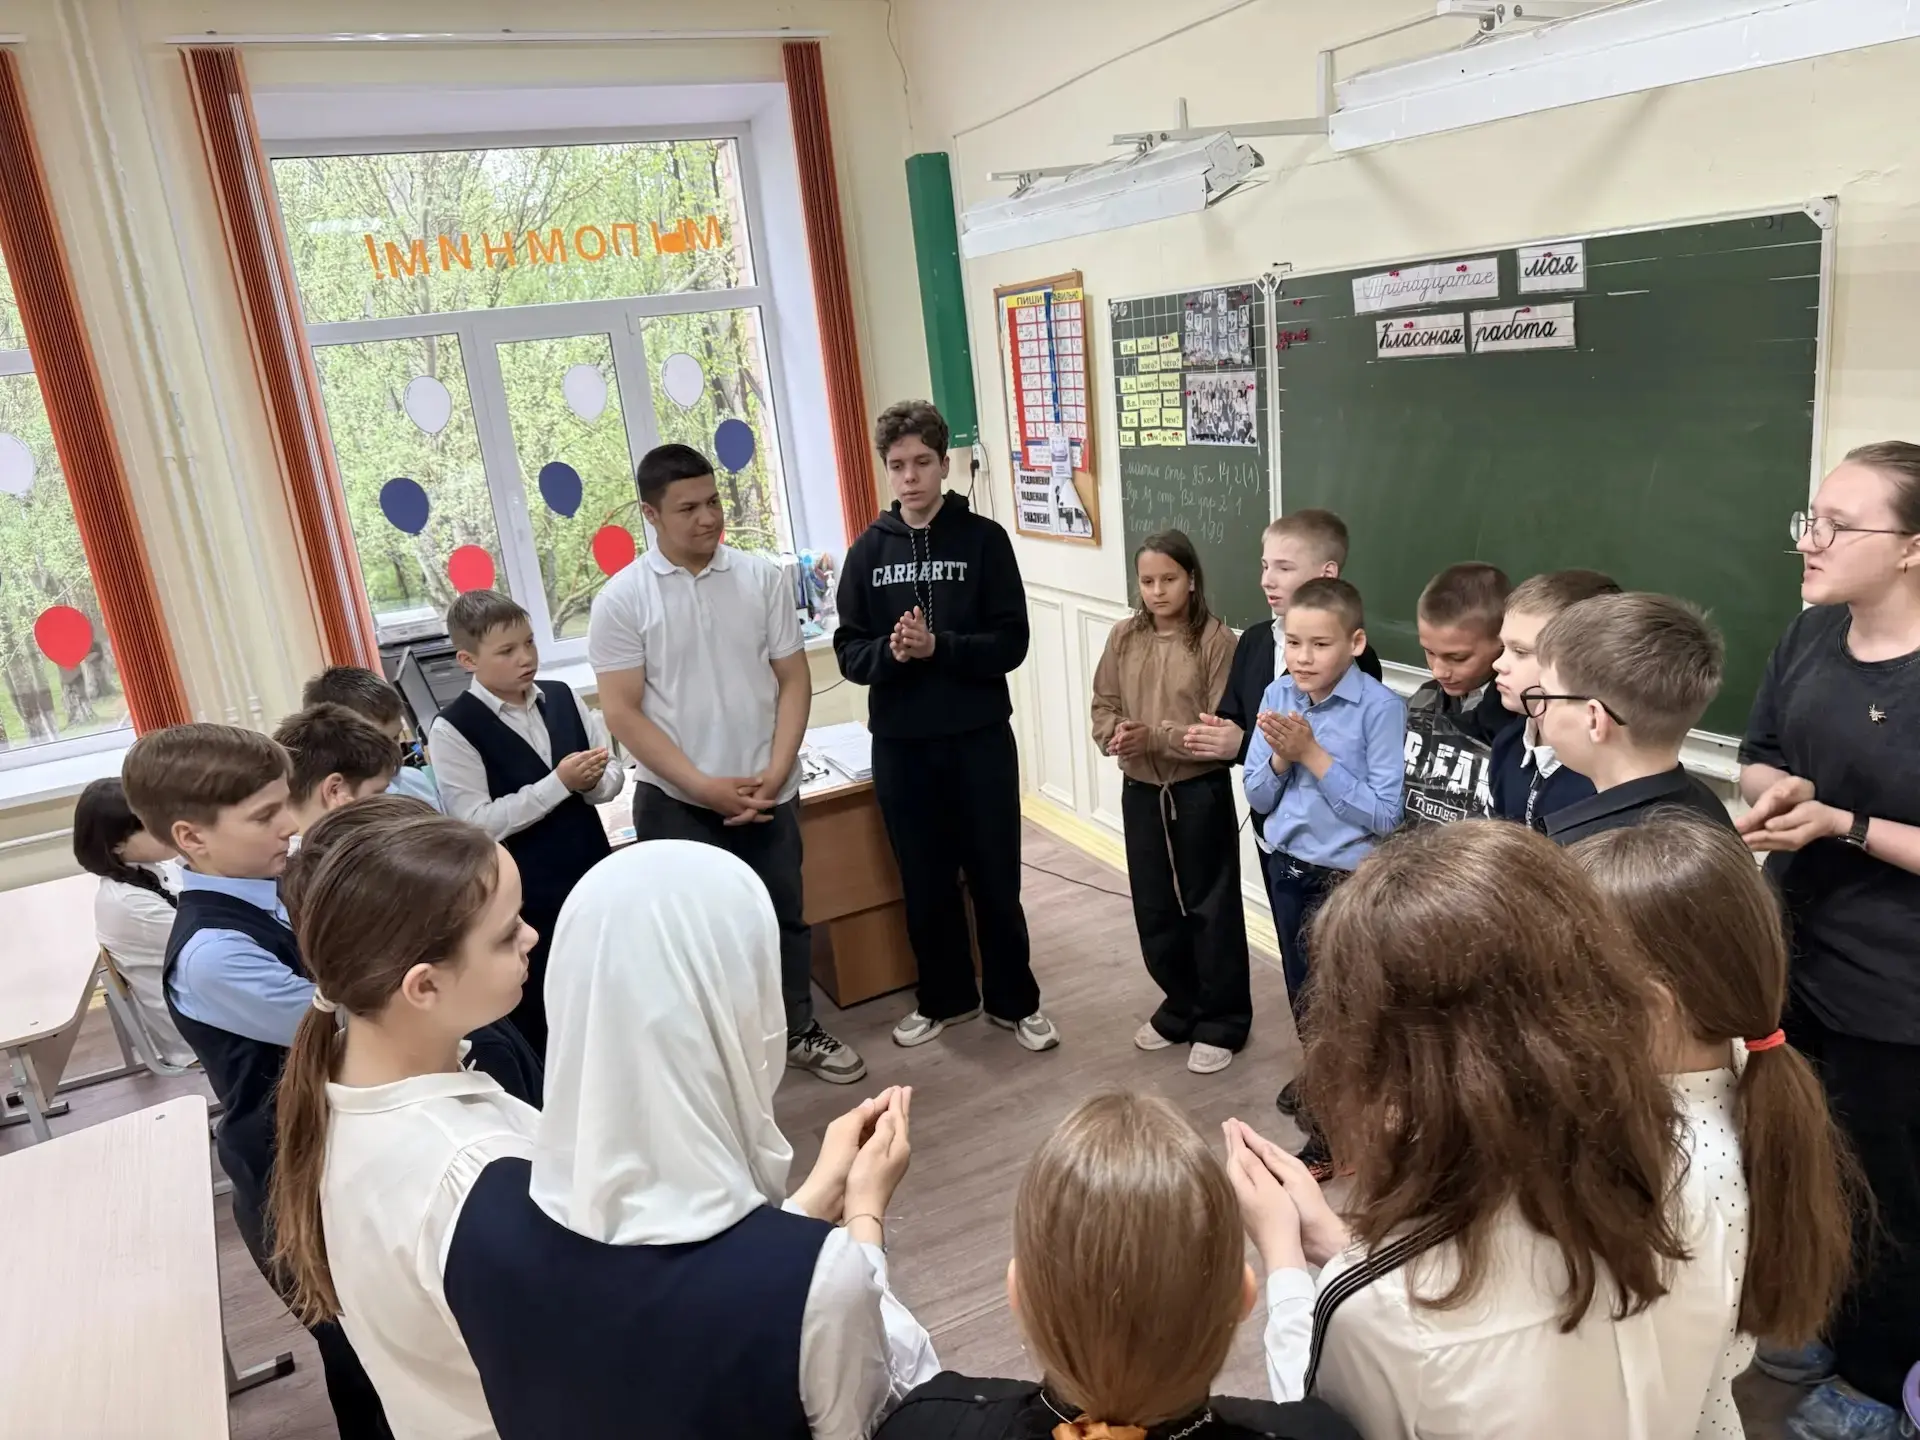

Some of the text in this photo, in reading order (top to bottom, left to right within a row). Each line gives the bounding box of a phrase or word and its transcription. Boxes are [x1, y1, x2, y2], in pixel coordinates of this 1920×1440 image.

[1362, 254, 1578, 307] Тринадцатое мая
[1379, 310, 1557, 353] Классная работа
[872, 560, 967, 588] CARHARTT
